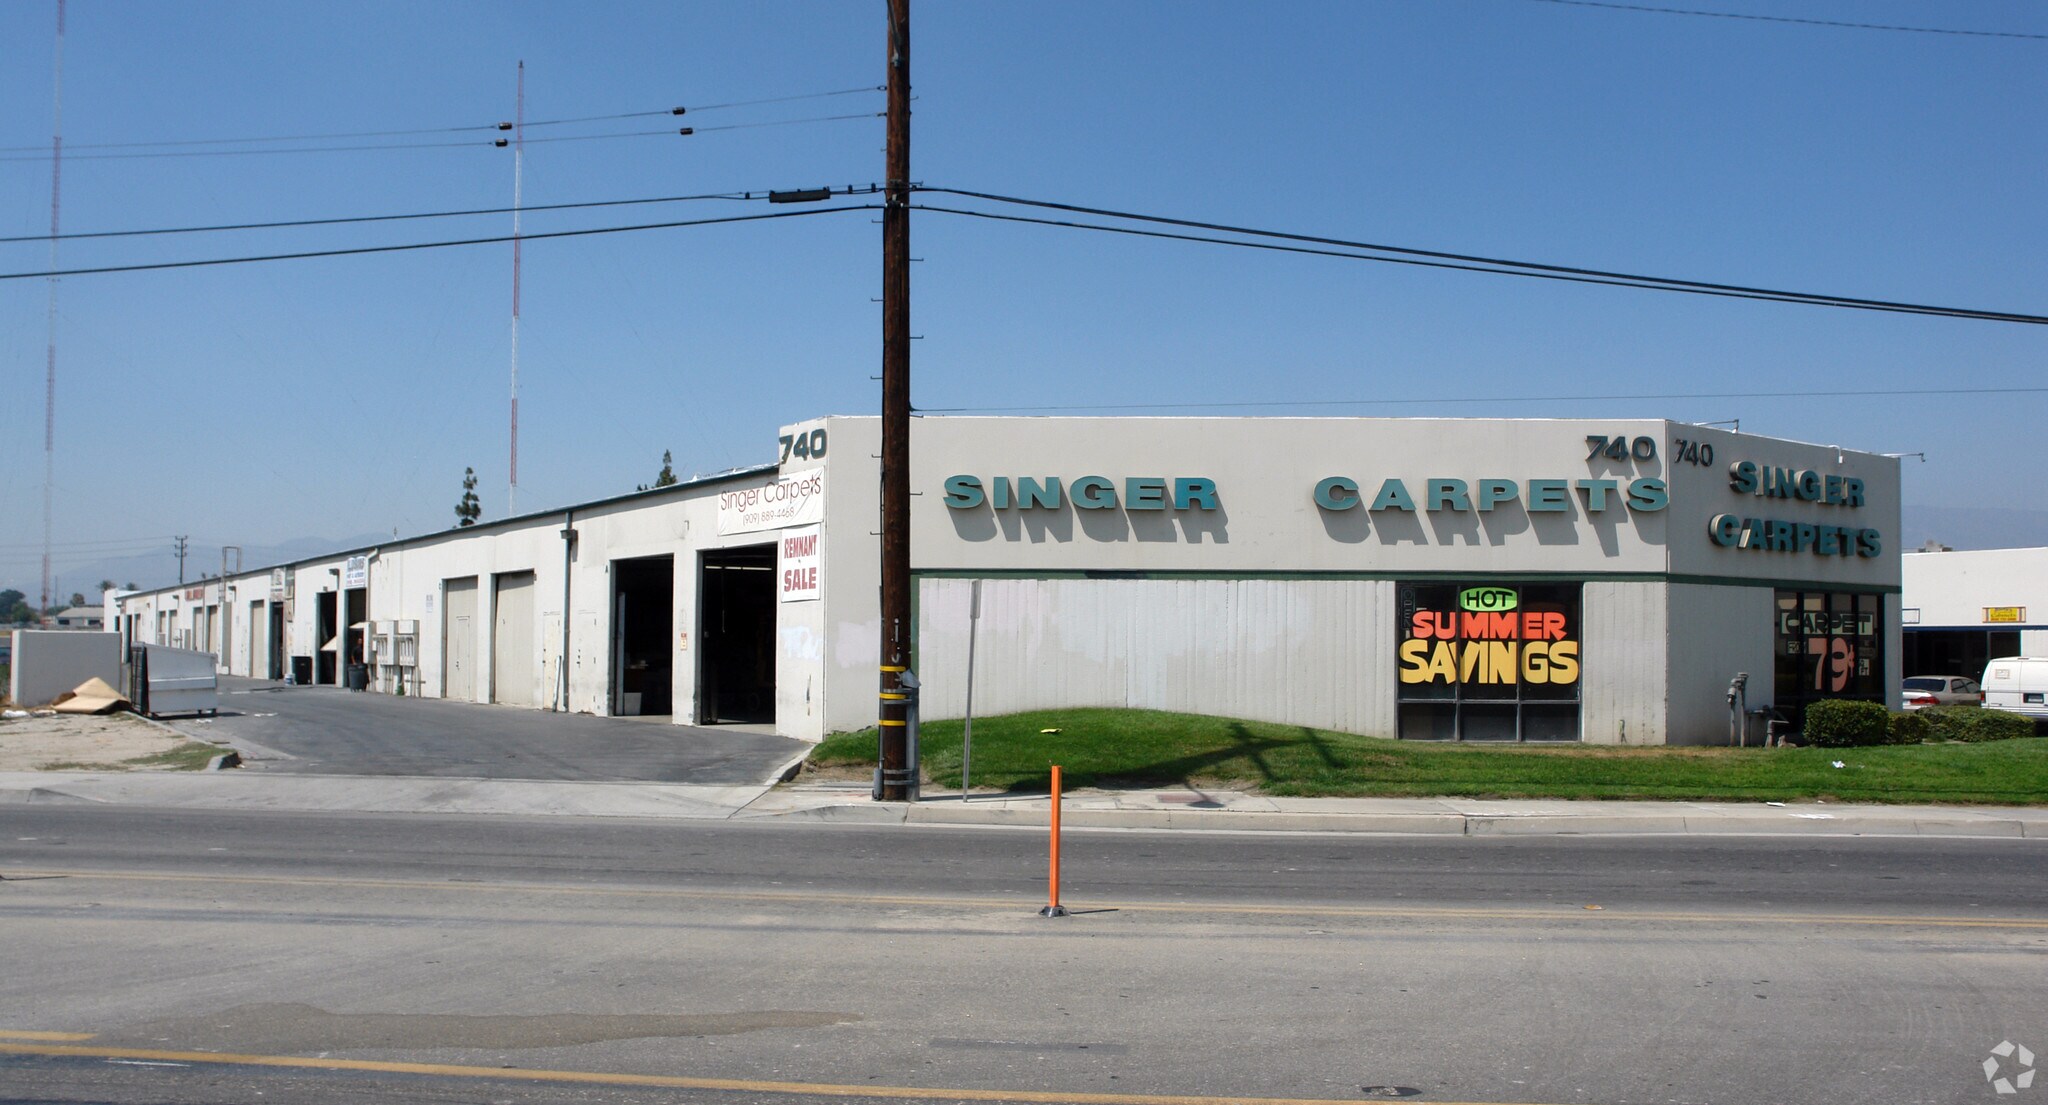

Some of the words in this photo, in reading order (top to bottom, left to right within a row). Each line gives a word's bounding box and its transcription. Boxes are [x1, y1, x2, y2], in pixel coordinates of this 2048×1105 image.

[779, 428, 828, 464] 740
[1585, 435, 1656, 462] 740
[1674, 438, 1714, 467] 740
[720, 488, 761, 513] Singer
[763, 474, 821, 503] Carpets
[943, 475, 1217, 511] SINGER
[1313, 476, 1670, 513] CARPETS
[1729, 461, 1865, 507] SINGER
[743, 511, 760, 526] (909)
[784, 534, 818, 559] REMNANT
[1708, 513, 1882, 558] CARPETS
[784, 567, 817, 592] SALE
[1465, 590, 1513, 608] HOT
[1412, 610, 1568, 641] SUMMER
[1785, 611, 1871, 635] CARPET
[1399, 638, 1580, 685] SAVINGS
